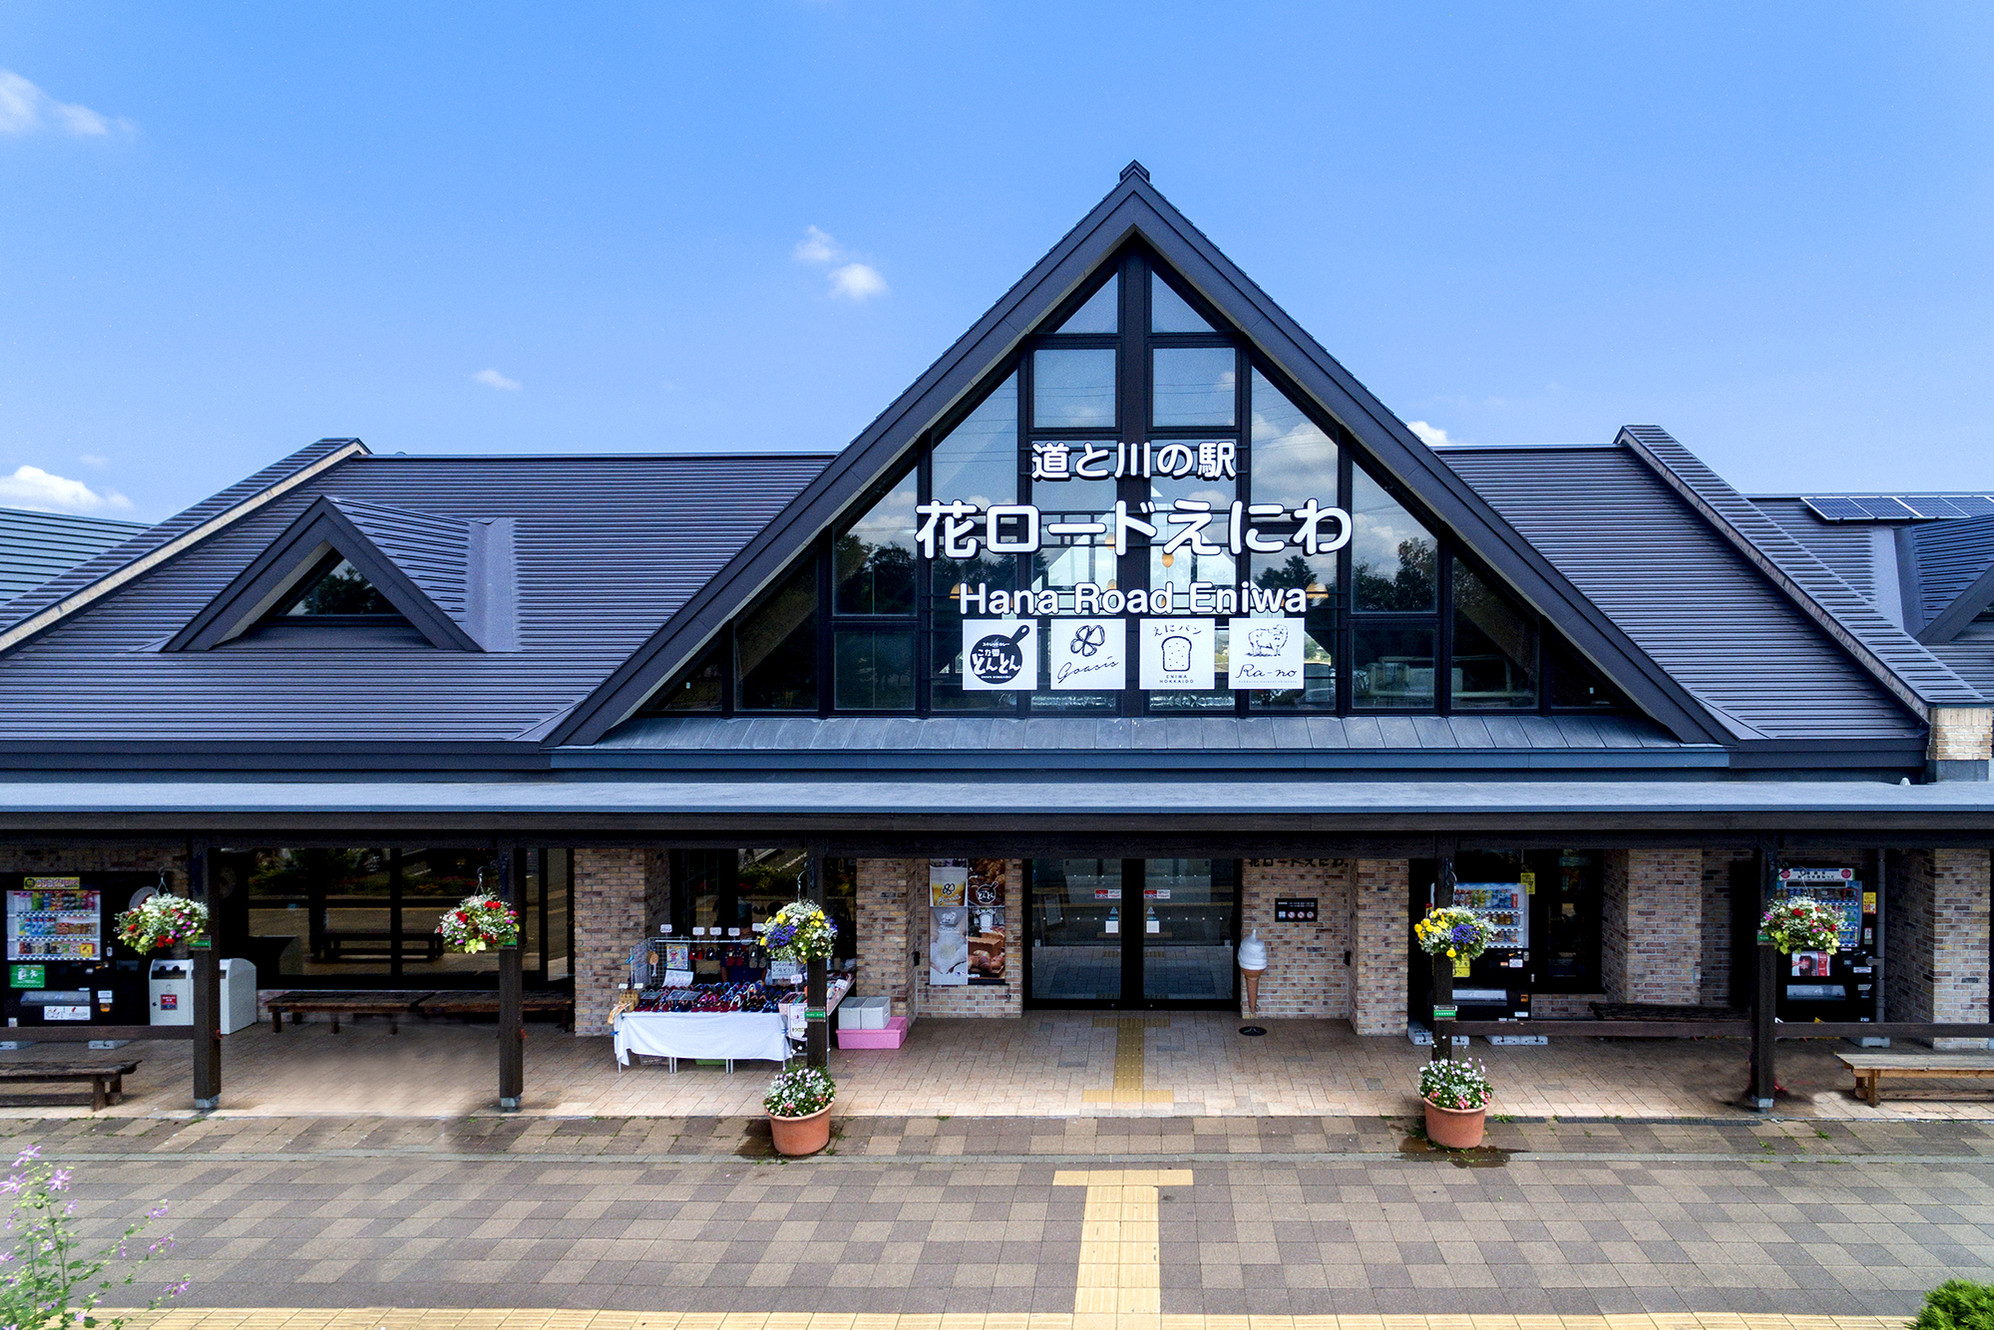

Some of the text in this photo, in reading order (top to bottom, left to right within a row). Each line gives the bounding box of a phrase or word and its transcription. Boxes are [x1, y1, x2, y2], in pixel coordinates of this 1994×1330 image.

[1031, 441, 1237, 480] 道と川の駅
[914, 499, 1354, 559] 花ロードえにわ
[959, 581, 1307, 615] Hana Road Eniwa
[1153, 624, 1202, 637] えにパン
[971, 653, 1022, 675] とんとん
[1057, 655, 1119, 684] Goasis
[1235, 663, 1298, 679] Ra-no
